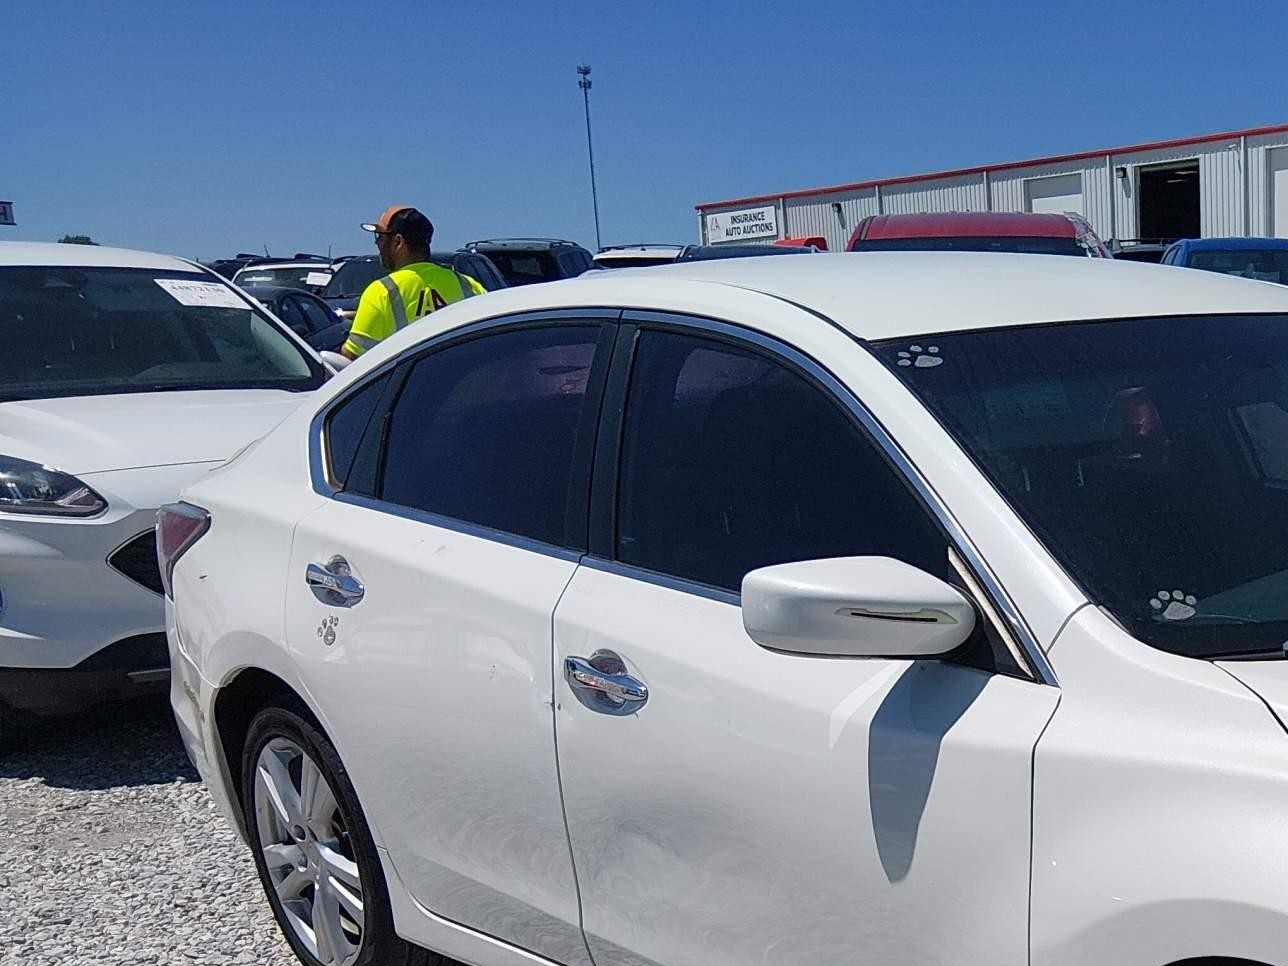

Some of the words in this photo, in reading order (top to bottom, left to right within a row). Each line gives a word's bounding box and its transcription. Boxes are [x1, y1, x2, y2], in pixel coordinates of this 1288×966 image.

[731, 212, 765, 224] INSURANCE
[725, 227, 741, 237] AUTO
[743, 222, 774, 234] AUCTIONS
